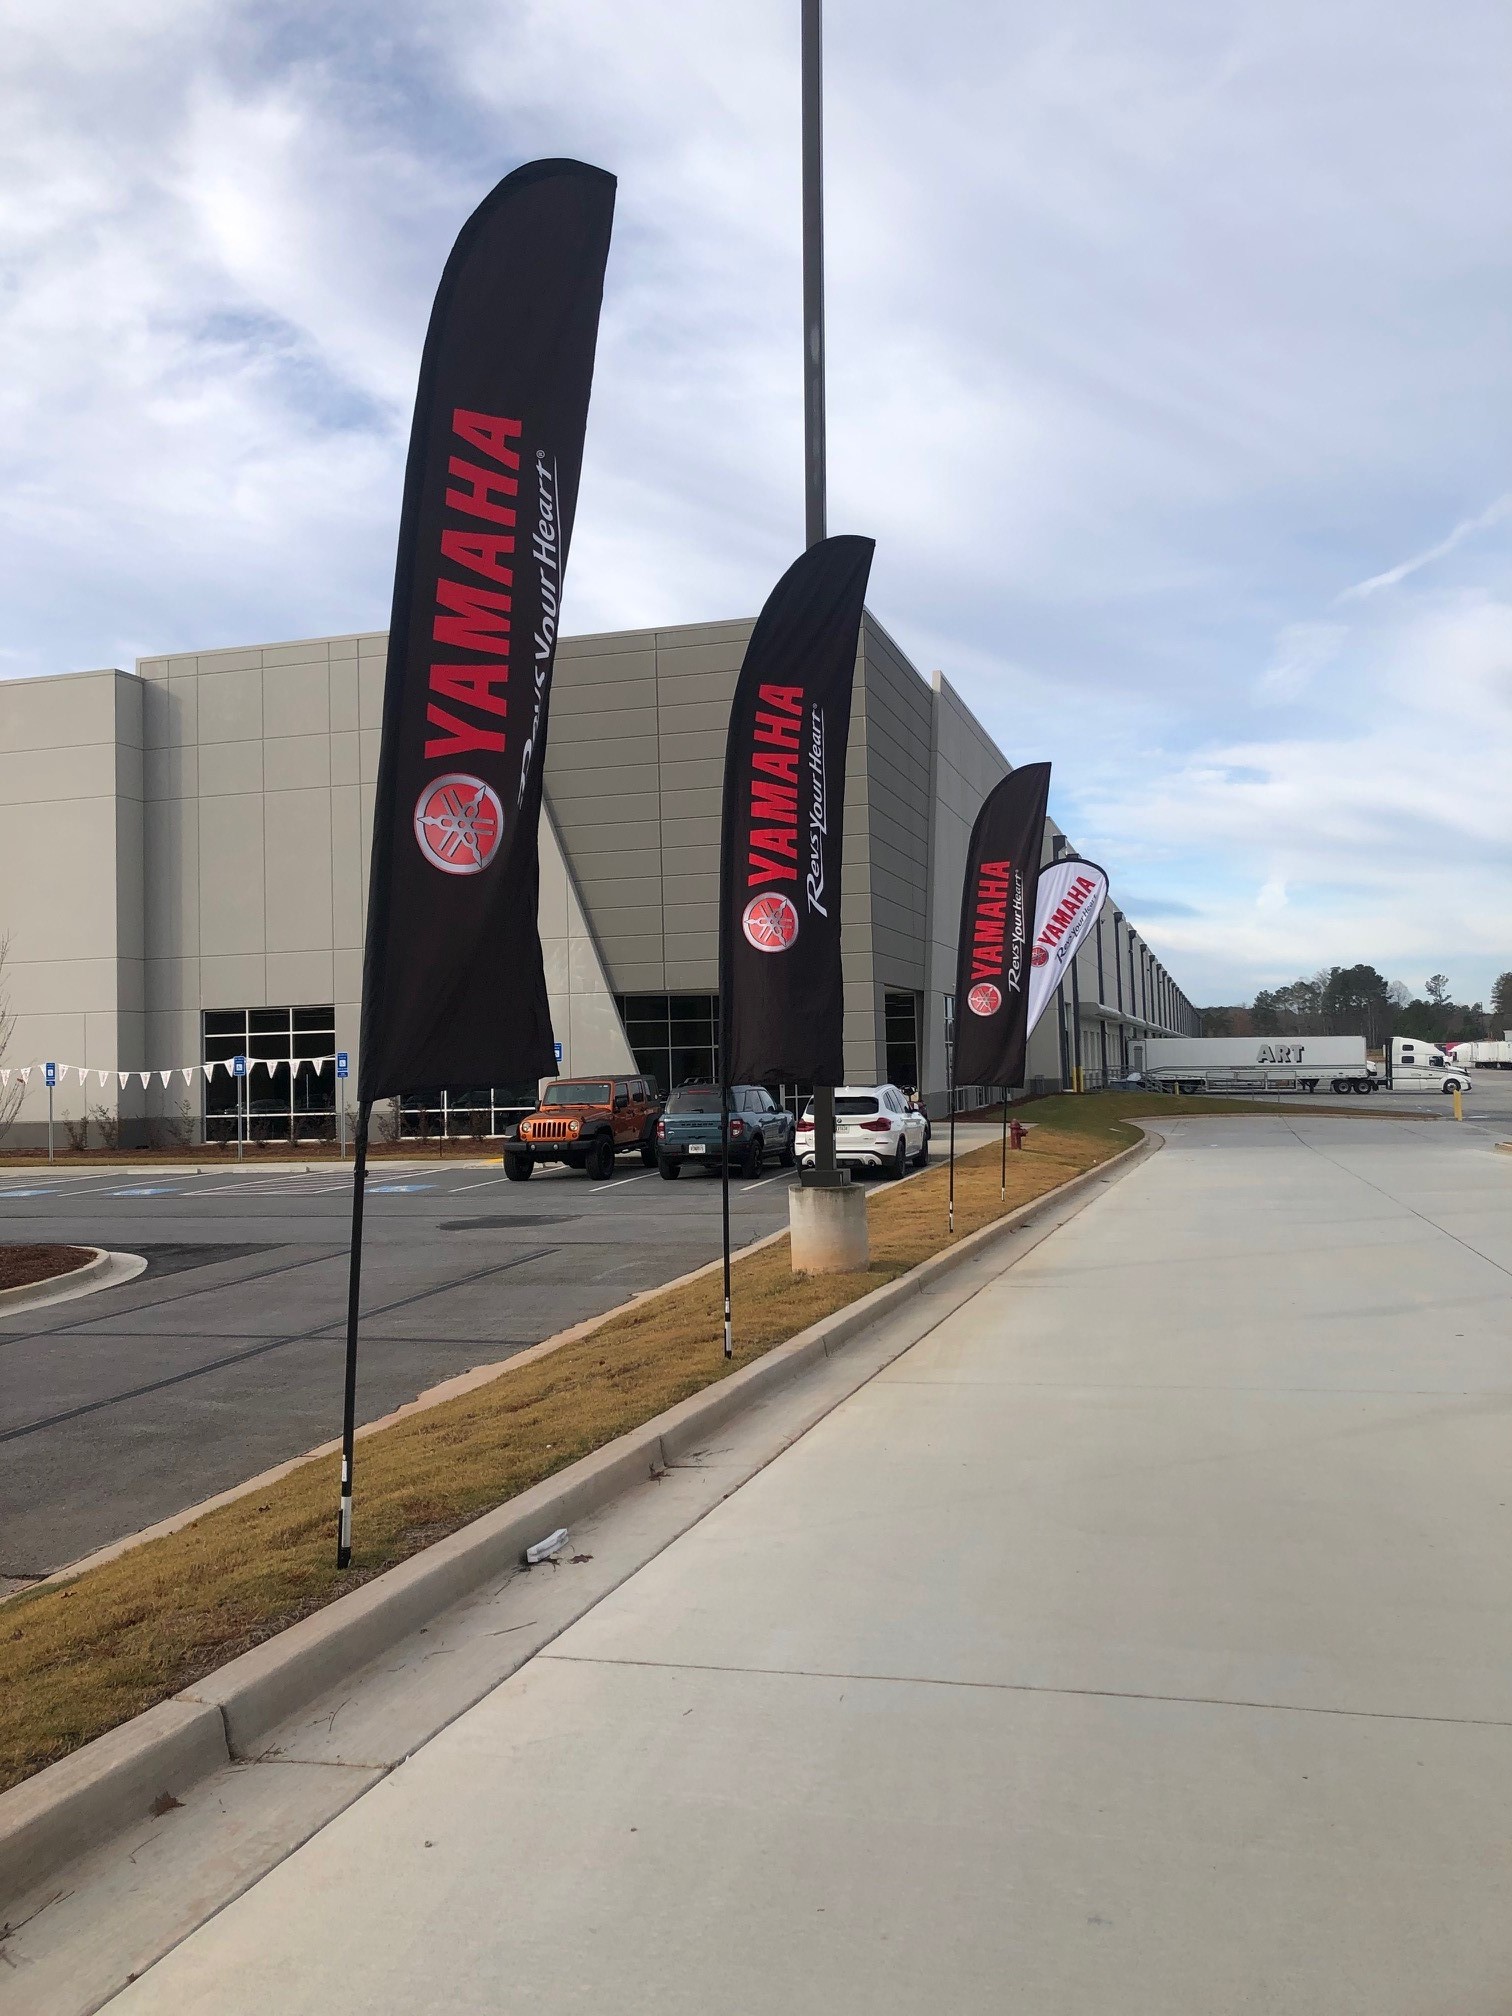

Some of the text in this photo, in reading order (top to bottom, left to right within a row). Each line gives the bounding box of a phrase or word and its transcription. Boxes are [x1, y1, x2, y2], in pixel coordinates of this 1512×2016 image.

[424, 408, 523, 760] YAMAHA
[748, 684, 804, 887] YAMAHA
[808, 773, 828, 835] Your
[806, 832, 828, 918] Revs
[970, 860, 1011, 980] YAMAHA
[1012, 910, 1025, 944] Your
[1037, 876, 1096, 947] YAMAHA
[1008, 942, 1023, 993] Revs
[1256, 1045, 1305, 1063] ART
